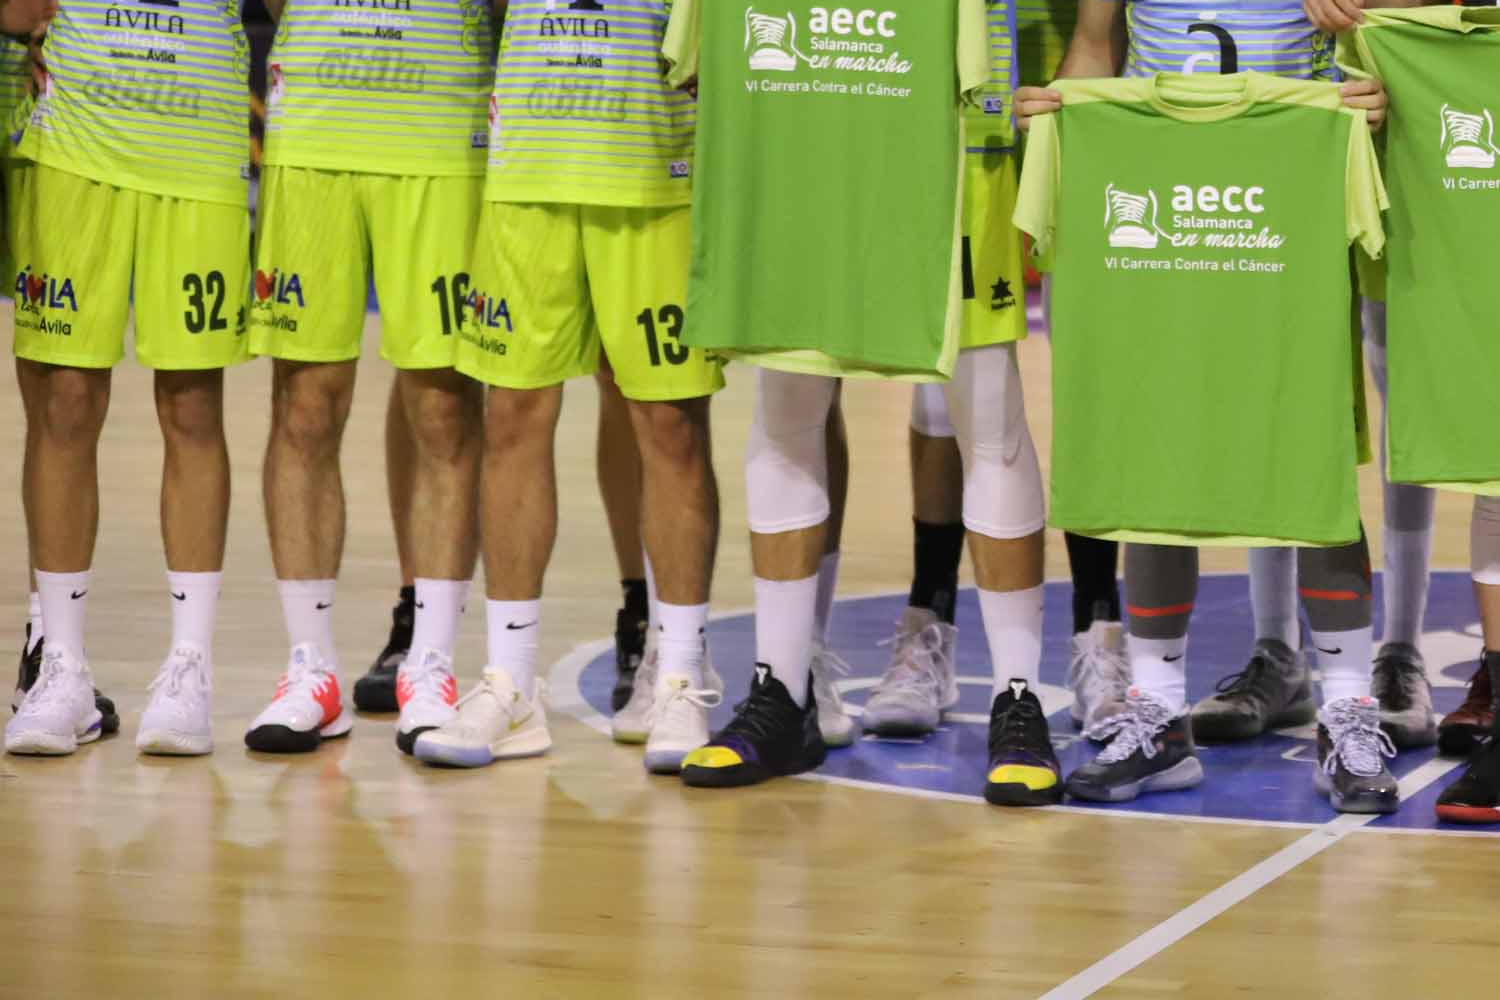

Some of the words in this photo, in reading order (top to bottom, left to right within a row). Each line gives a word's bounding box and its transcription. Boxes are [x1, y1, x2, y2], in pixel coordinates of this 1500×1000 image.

[104, 2, 185, 36] ÁVILA
[539, 12, 609, 38] ÁVILA
[808, 6, 897, 38] aecc
[810, 36, 884, 54] Salamanca
[808, 53, 832, 69] en
[834, 50, 913, 74] marcha
[744, 79, 759, 92] VI
[760, 79, 810, 93] Carrera
[850, 81, 864, 95] el
[866, 81, 912, 97] Cáncer
[1441, 176, 1456, 190] VI
[1170, 184, 1266, 213] aecc
[1172, 215, 1254, 230] Salamanca
[1170, 231, 1199, 247] en
[1203, 226, 1287, 249] marcha
[1103, 256, 1118, 269] VI
[1120, 256, 1171, 270] Carrera
[1174, 257, 1219, 271] Contra
[1222, 258, 1235, 272] el
[1237, 257, 1286, 273] Cáncer
[181, 270, 228, 334] 32
[636, 304, 690, 367] 13
